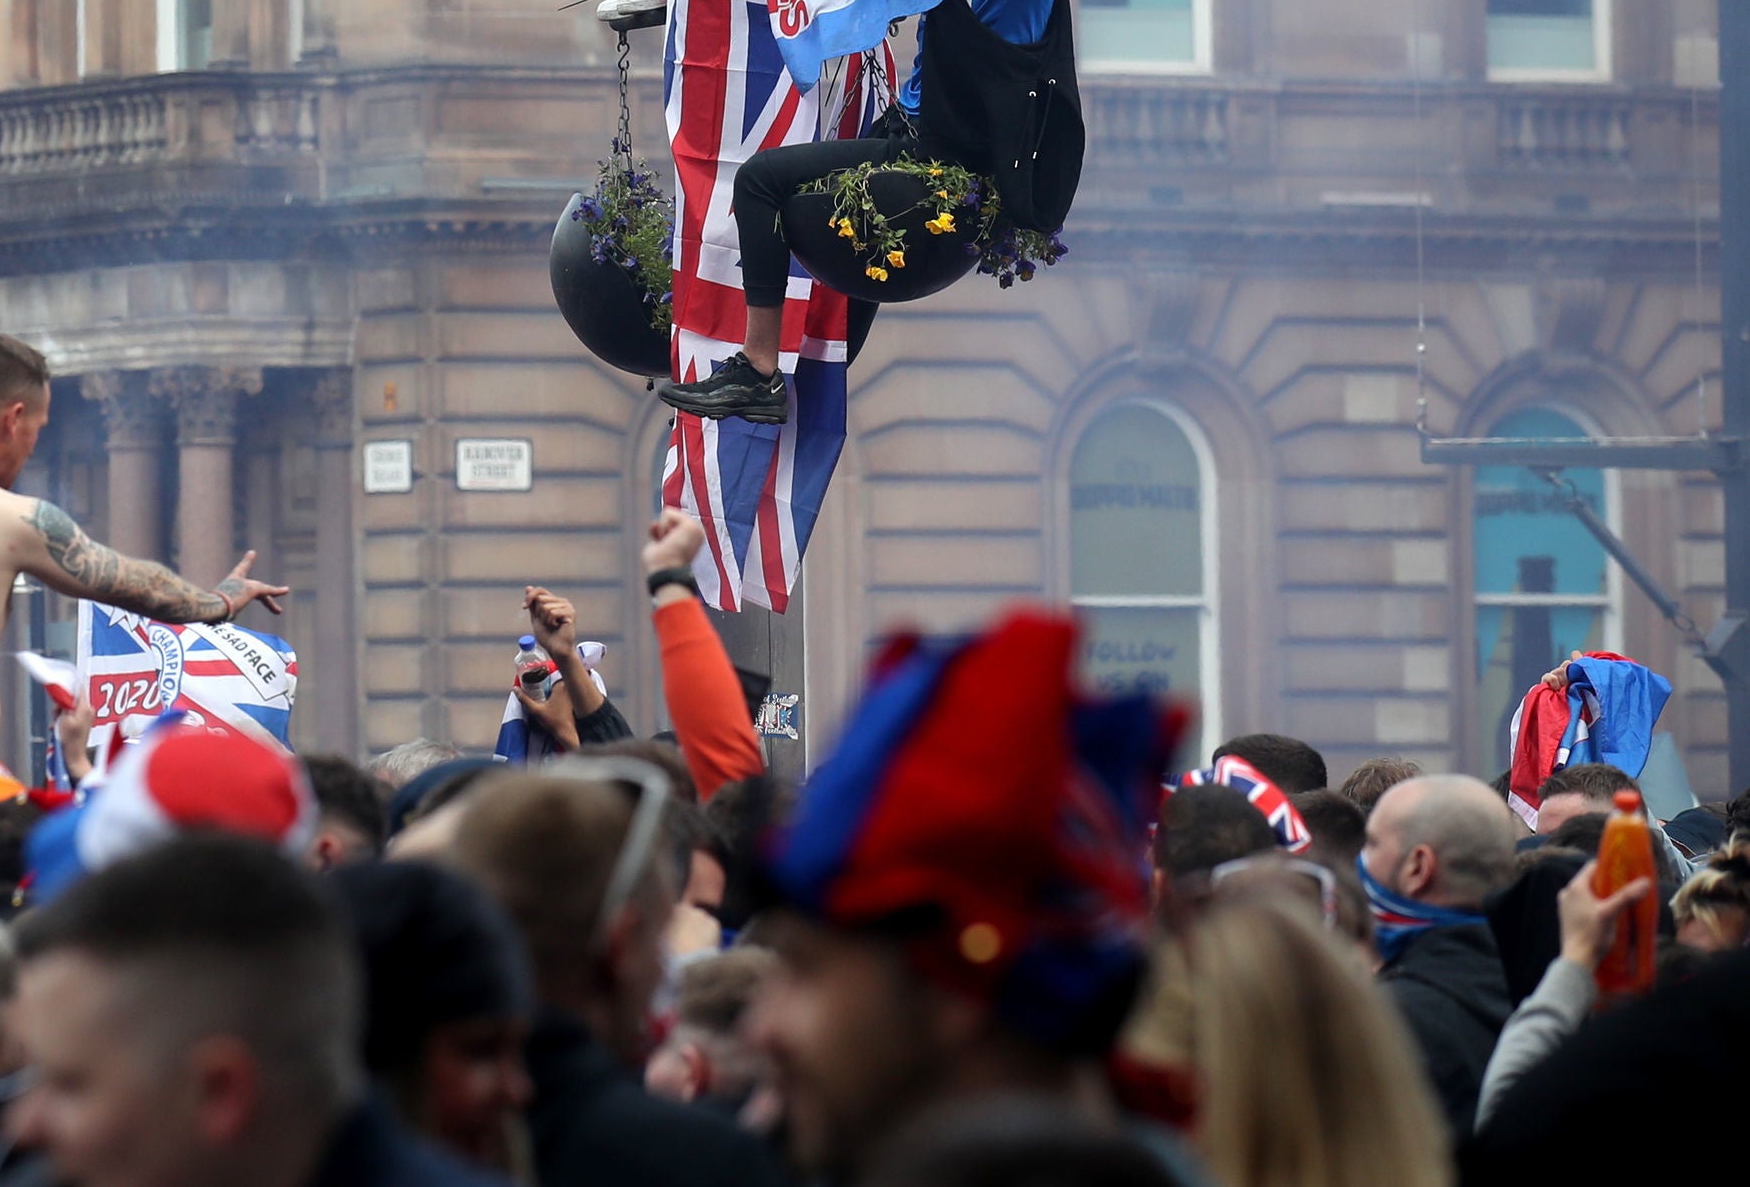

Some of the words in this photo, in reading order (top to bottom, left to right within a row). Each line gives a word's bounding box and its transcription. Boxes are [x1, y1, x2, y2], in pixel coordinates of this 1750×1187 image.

[152, 627, 178, 708] CHAMPION
[221, 632, 249, 652] SAD
[243, 648, 276, 684] FACE
[97, 678, 161, 718] 2020
